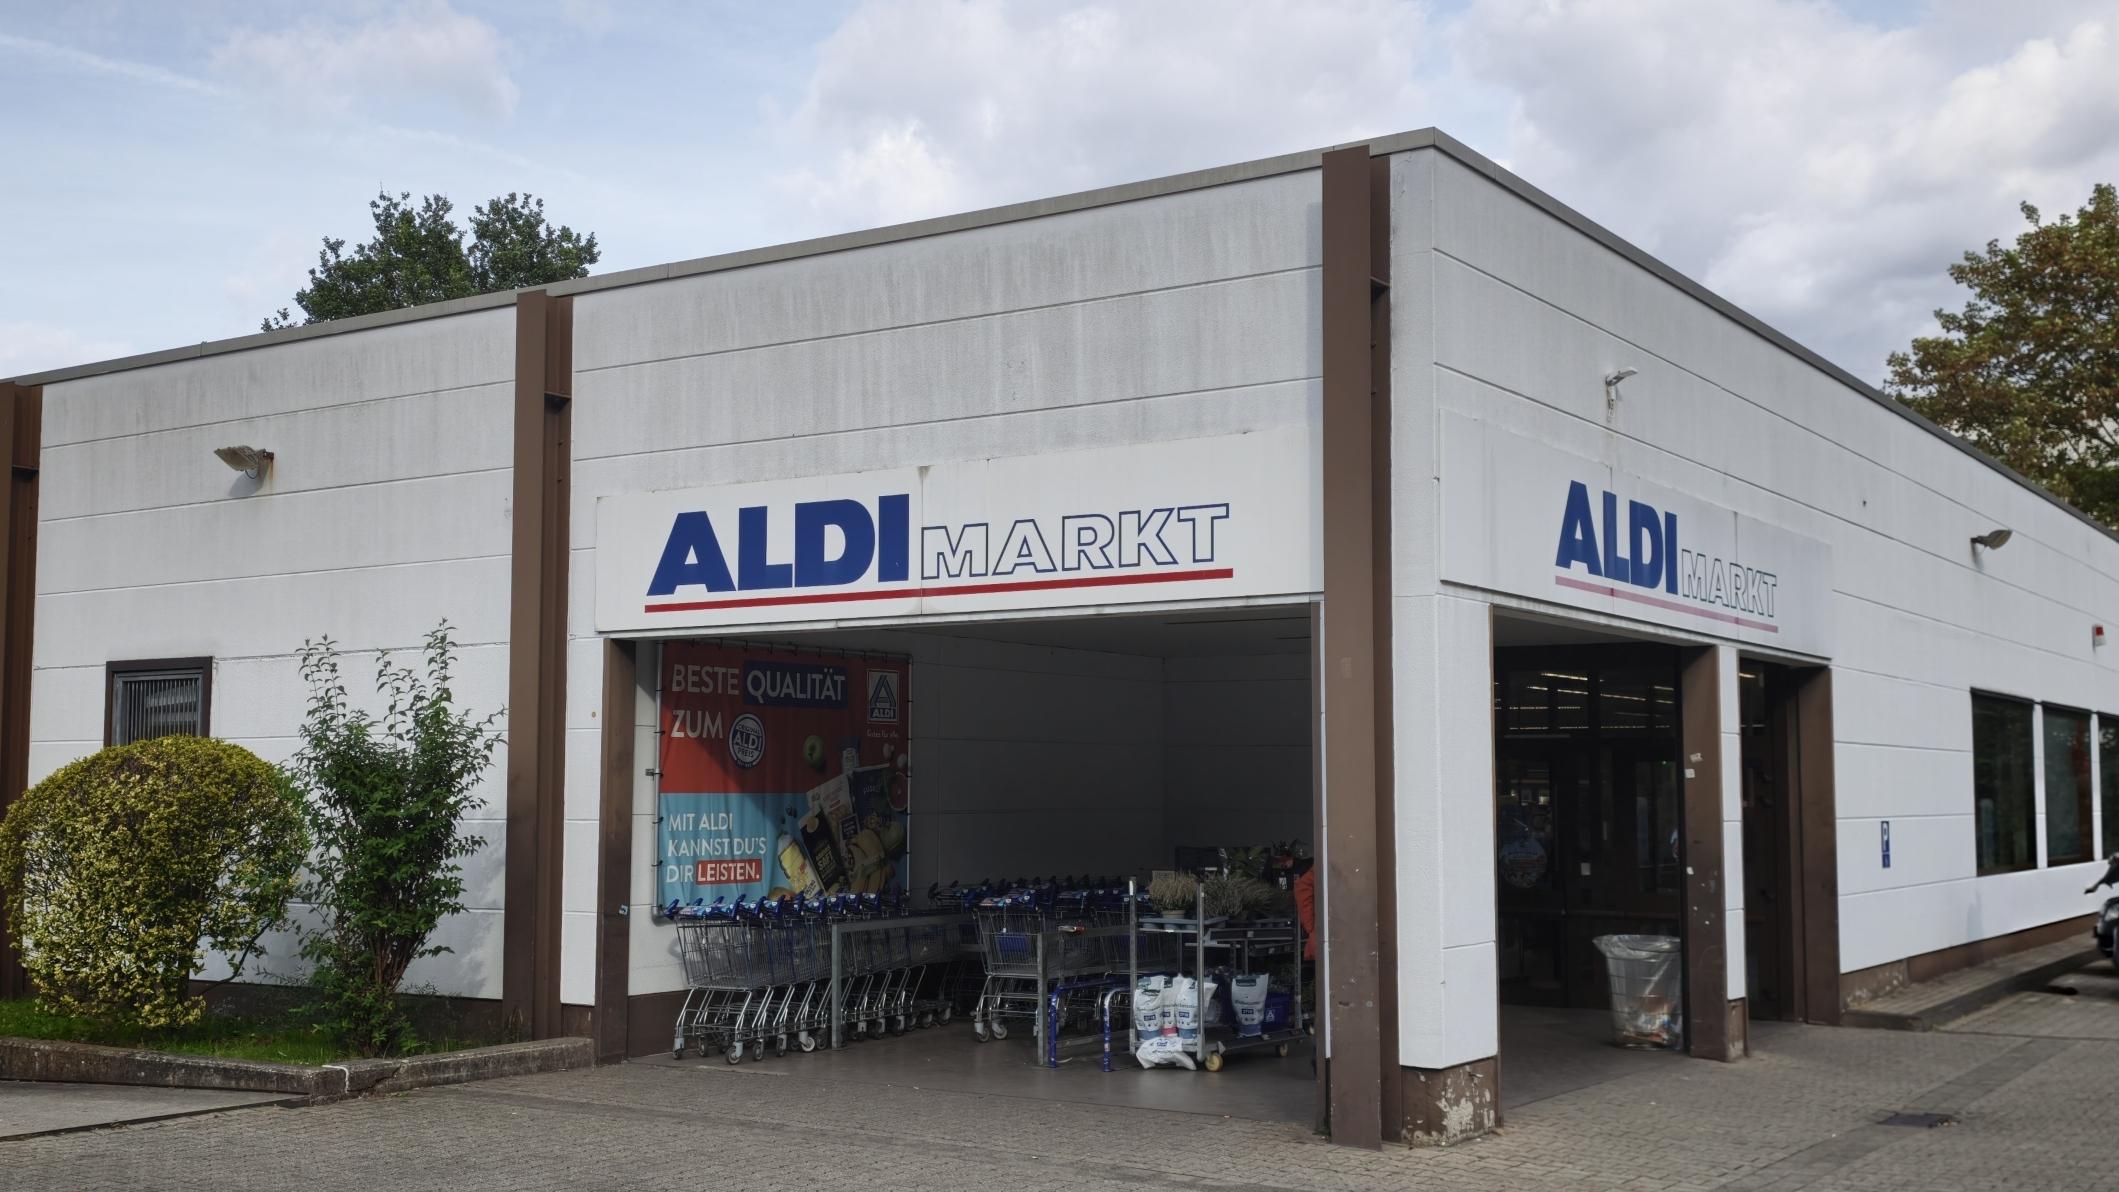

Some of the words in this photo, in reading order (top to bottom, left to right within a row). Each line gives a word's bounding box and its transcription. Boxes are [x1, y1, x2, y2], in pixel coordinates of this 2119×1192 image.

[646, 494, 910, 597] ALDI
[921, 503, 1230, 580] MARKT
[1555, 480, 1679, 596] ALDI
[1681, 548, 1778, 618] MARKT
[671, 664, 739, 695] BESTE
[746, 667, 846, 704] QUALITÄT
[670, 709, 724, 739] ZUM
[872, 709, 894, 718] ALDI
[733, 730, 762, 751] ALDI
[668, 814, 696, 832] MIT
[699, 813, 733, 831] ALDI
[667, 838, 731, 857] KANNST
[733, 837, 767, 855] DU'S
[666, 865, 695, 883] DIR
[697, 862, 761, 883] LEISTEN.
